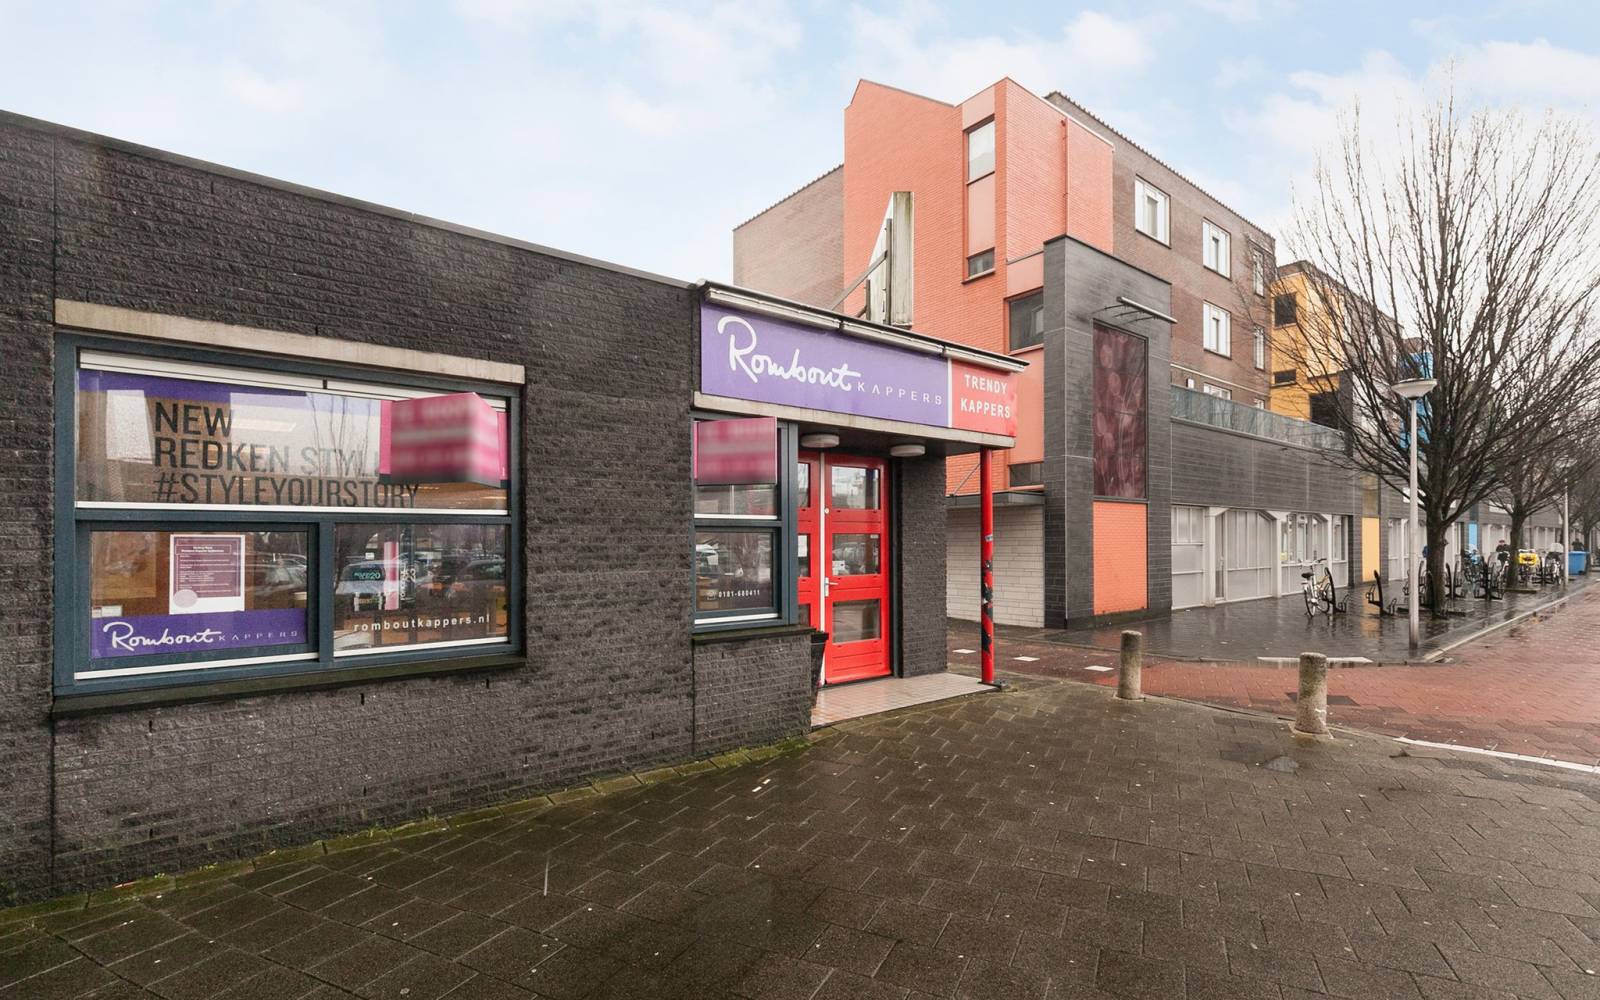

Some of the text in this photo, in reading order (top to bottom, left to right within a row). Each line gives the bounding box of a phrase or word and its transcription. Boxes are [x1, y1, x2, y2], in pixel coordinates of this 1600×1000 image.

[717, 315, 943, 406] Rombout KAPPERS
[964, 374, 1008, 395] TRENDY
[155, 401, 232, 437] NEW
[960, 397, 1011, 419] KAPPERS
[154, 436, 290, 473] REDKEN
[152, 472, 418, 508] #STYLEYOURSTORY
[103, 621, 223, 651] Rombout
[353, 613, 490, 632] romboutkappers.nl
